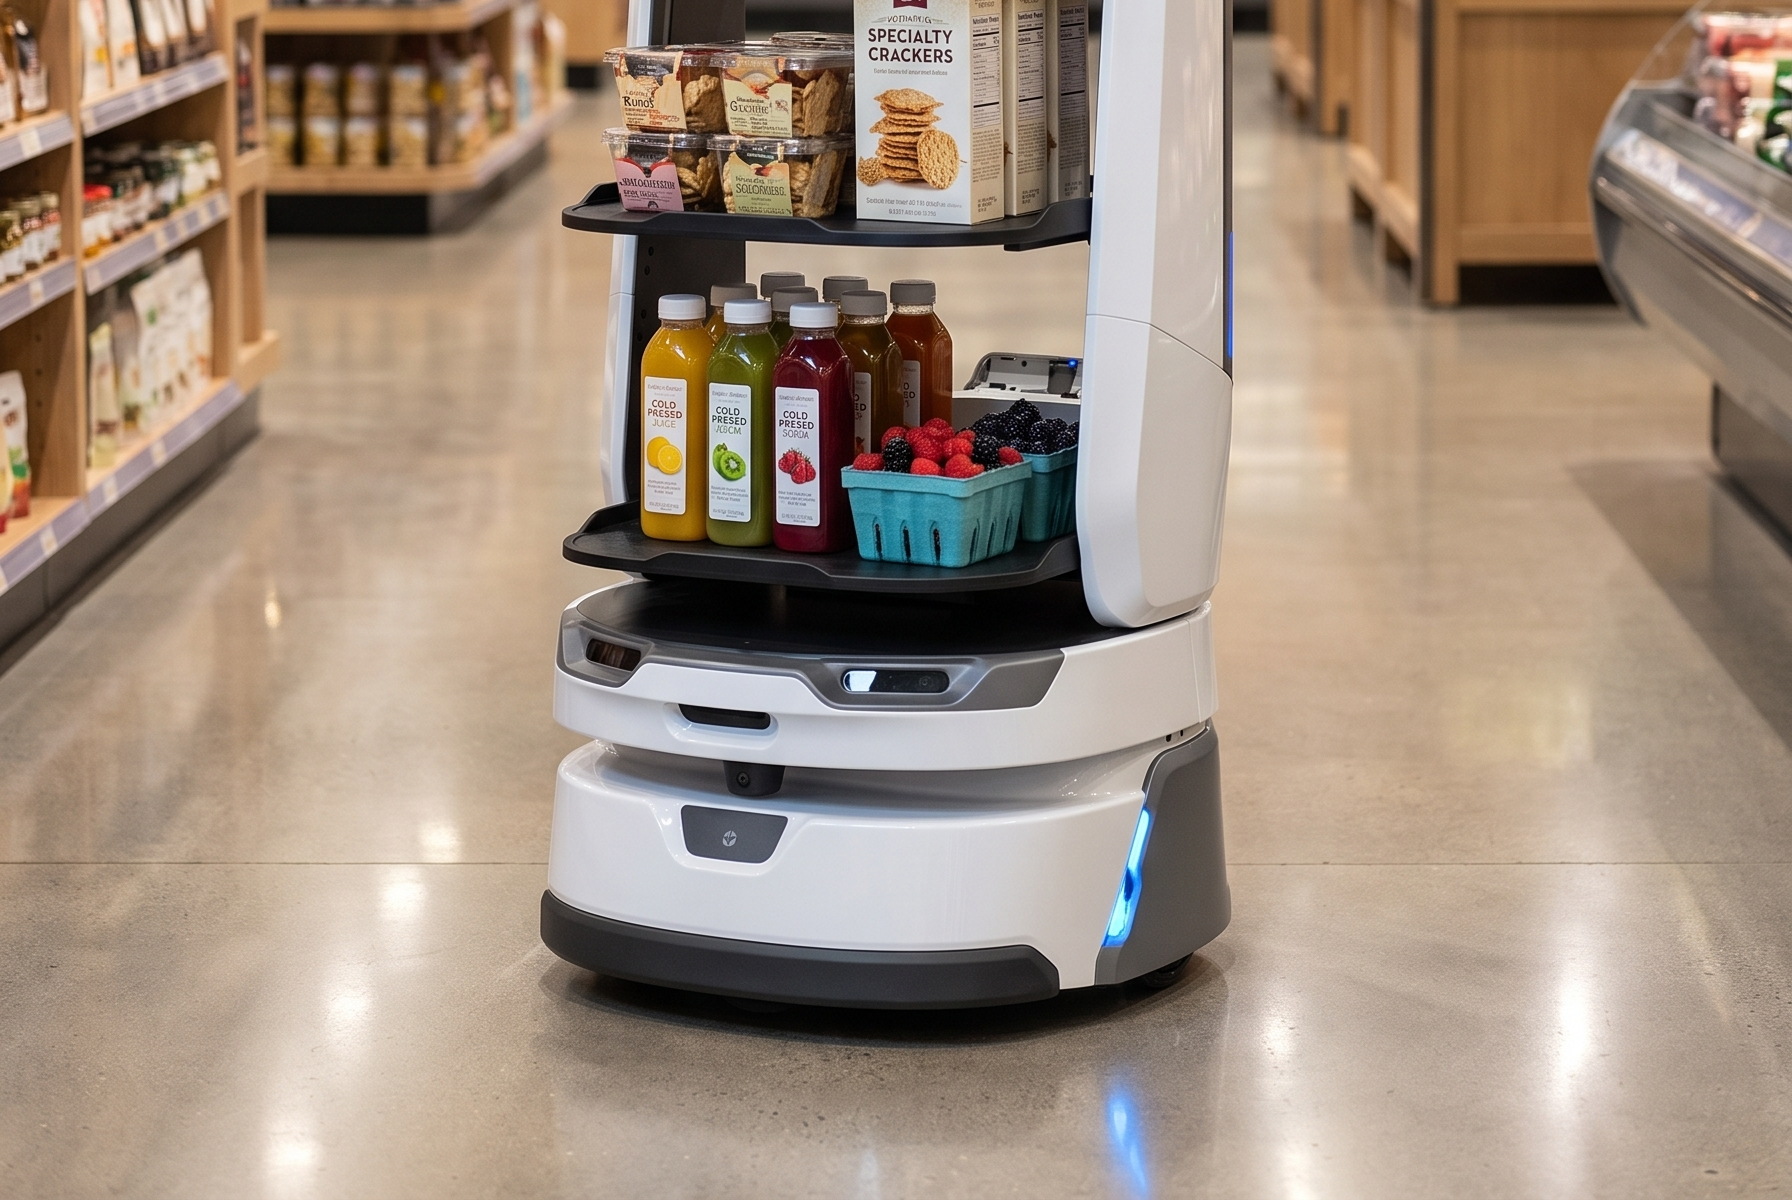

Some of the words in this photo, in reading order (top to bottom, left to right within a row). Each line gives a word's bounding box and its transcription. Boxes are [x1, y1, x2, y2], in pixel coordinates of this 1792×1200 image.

[868, 28, 953, 44] SPECIALTY
[868, 47, 953, 63] CRACKERS
[651, 399, 677, 409] COLD
[715, 406, 740, 416] COLD
[783, 410, 808, 420] COLD
[711, 415, 747, 426] PRESED
[779, 419, 815, 430] PRESED
